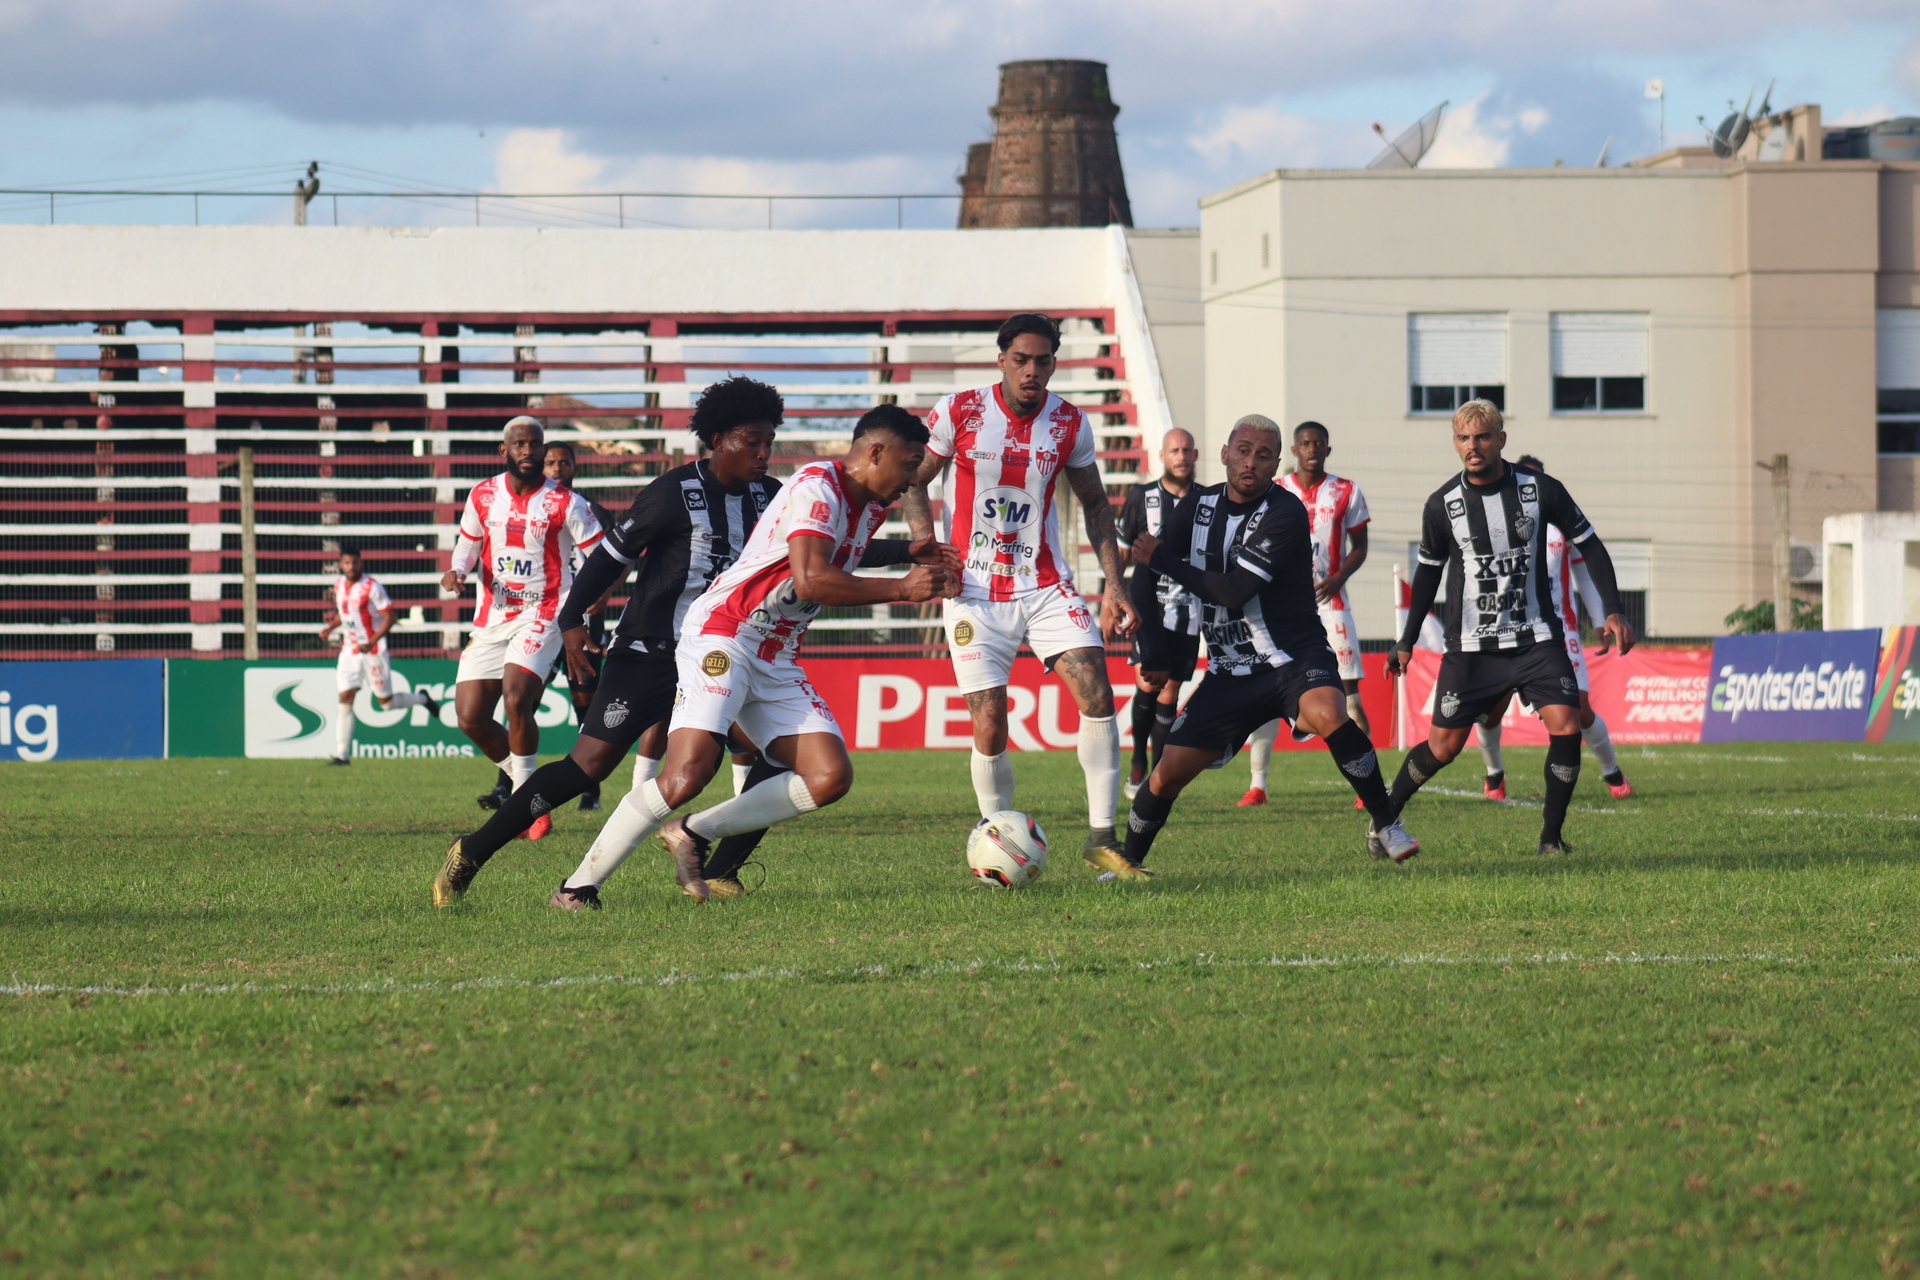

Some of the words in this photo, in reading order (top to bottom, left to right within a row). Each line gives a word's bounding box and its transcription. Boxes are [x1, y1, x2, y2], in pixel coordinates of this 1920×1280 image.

[991, 538, 1034, 558] Marfrig
[501, 587, 539, 601] Marfrig
[706, 657, 725, 669] GELEI
[1624, 689, 1643, 702] AS
[352, 739, 475, 758] Implantes
